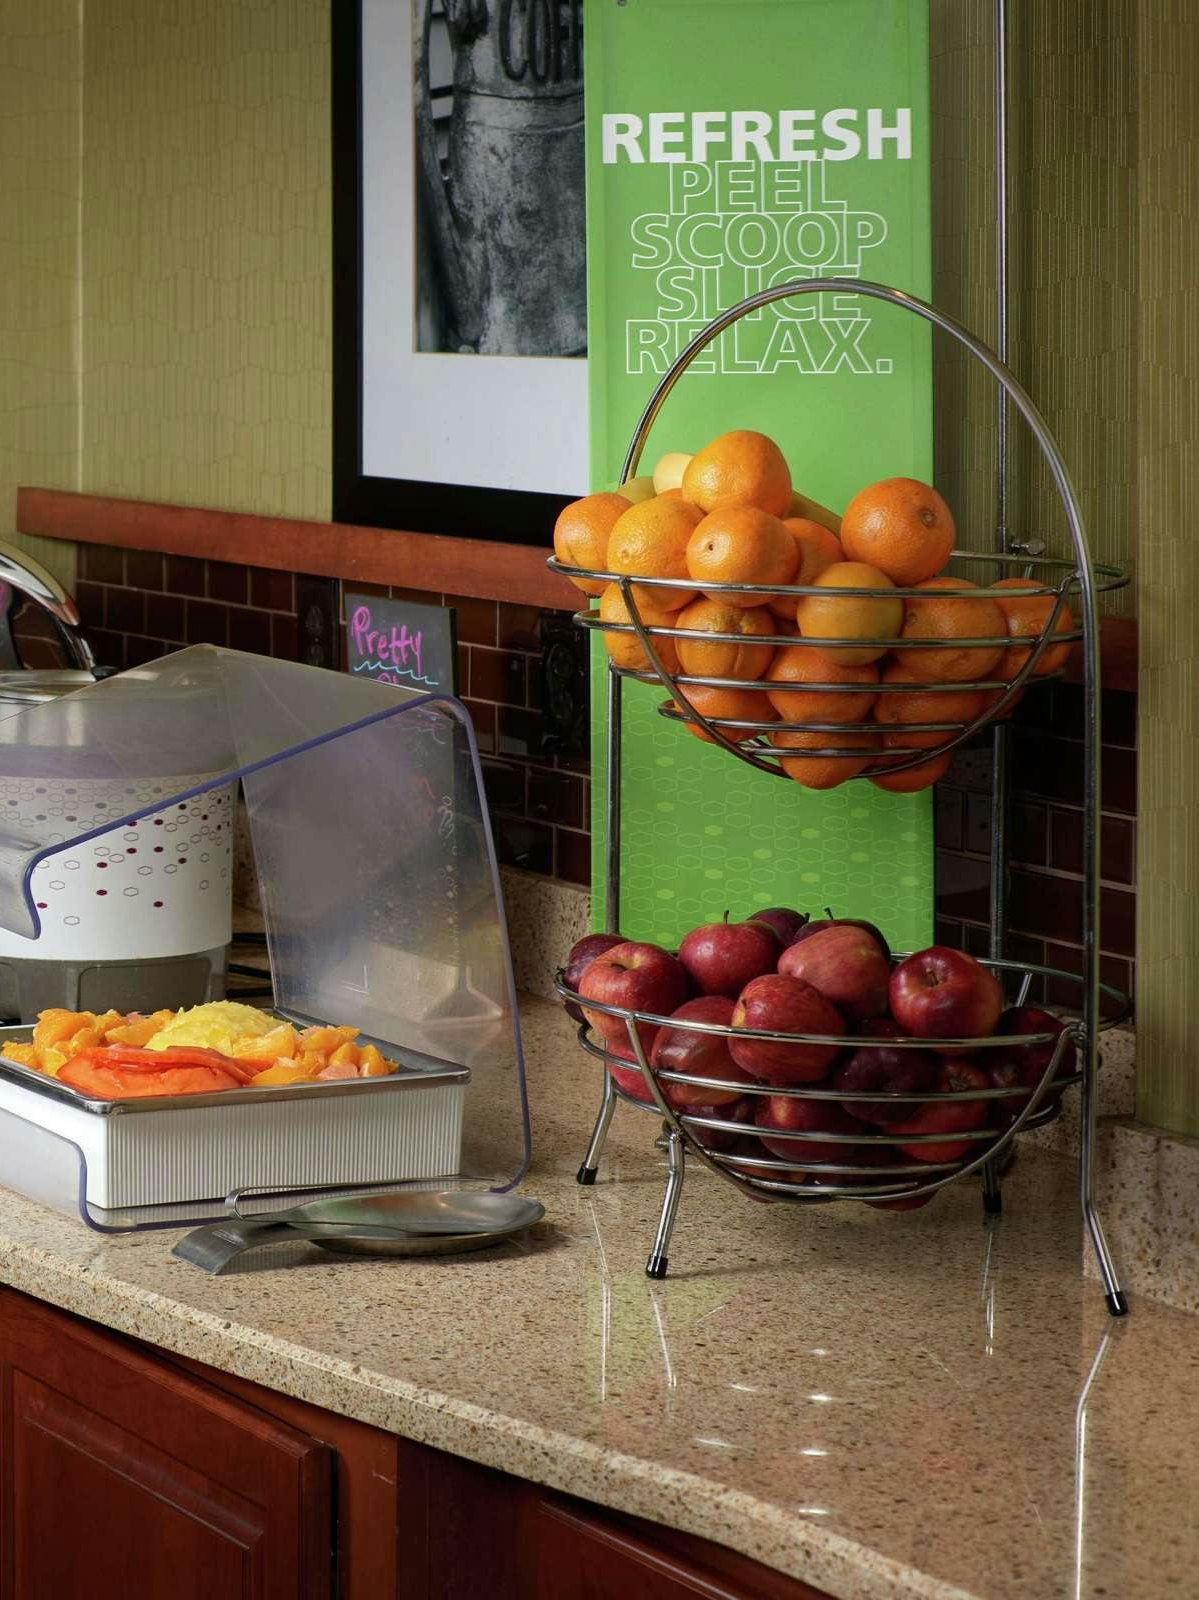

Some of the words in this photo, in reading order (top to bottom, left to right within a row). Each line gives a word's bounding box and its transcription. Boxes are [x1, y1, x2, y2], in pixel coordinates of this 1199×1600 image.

[602, 108, 911, 164] REFRESH
[669, 159, 847, 216] PEEL
[630, 212, 888, 268] SCOOP
[656, 265, 861, 321] SLICE
[626, 318, 894, 374] RELAX.
[352, 605, 423, 677] Pretty
